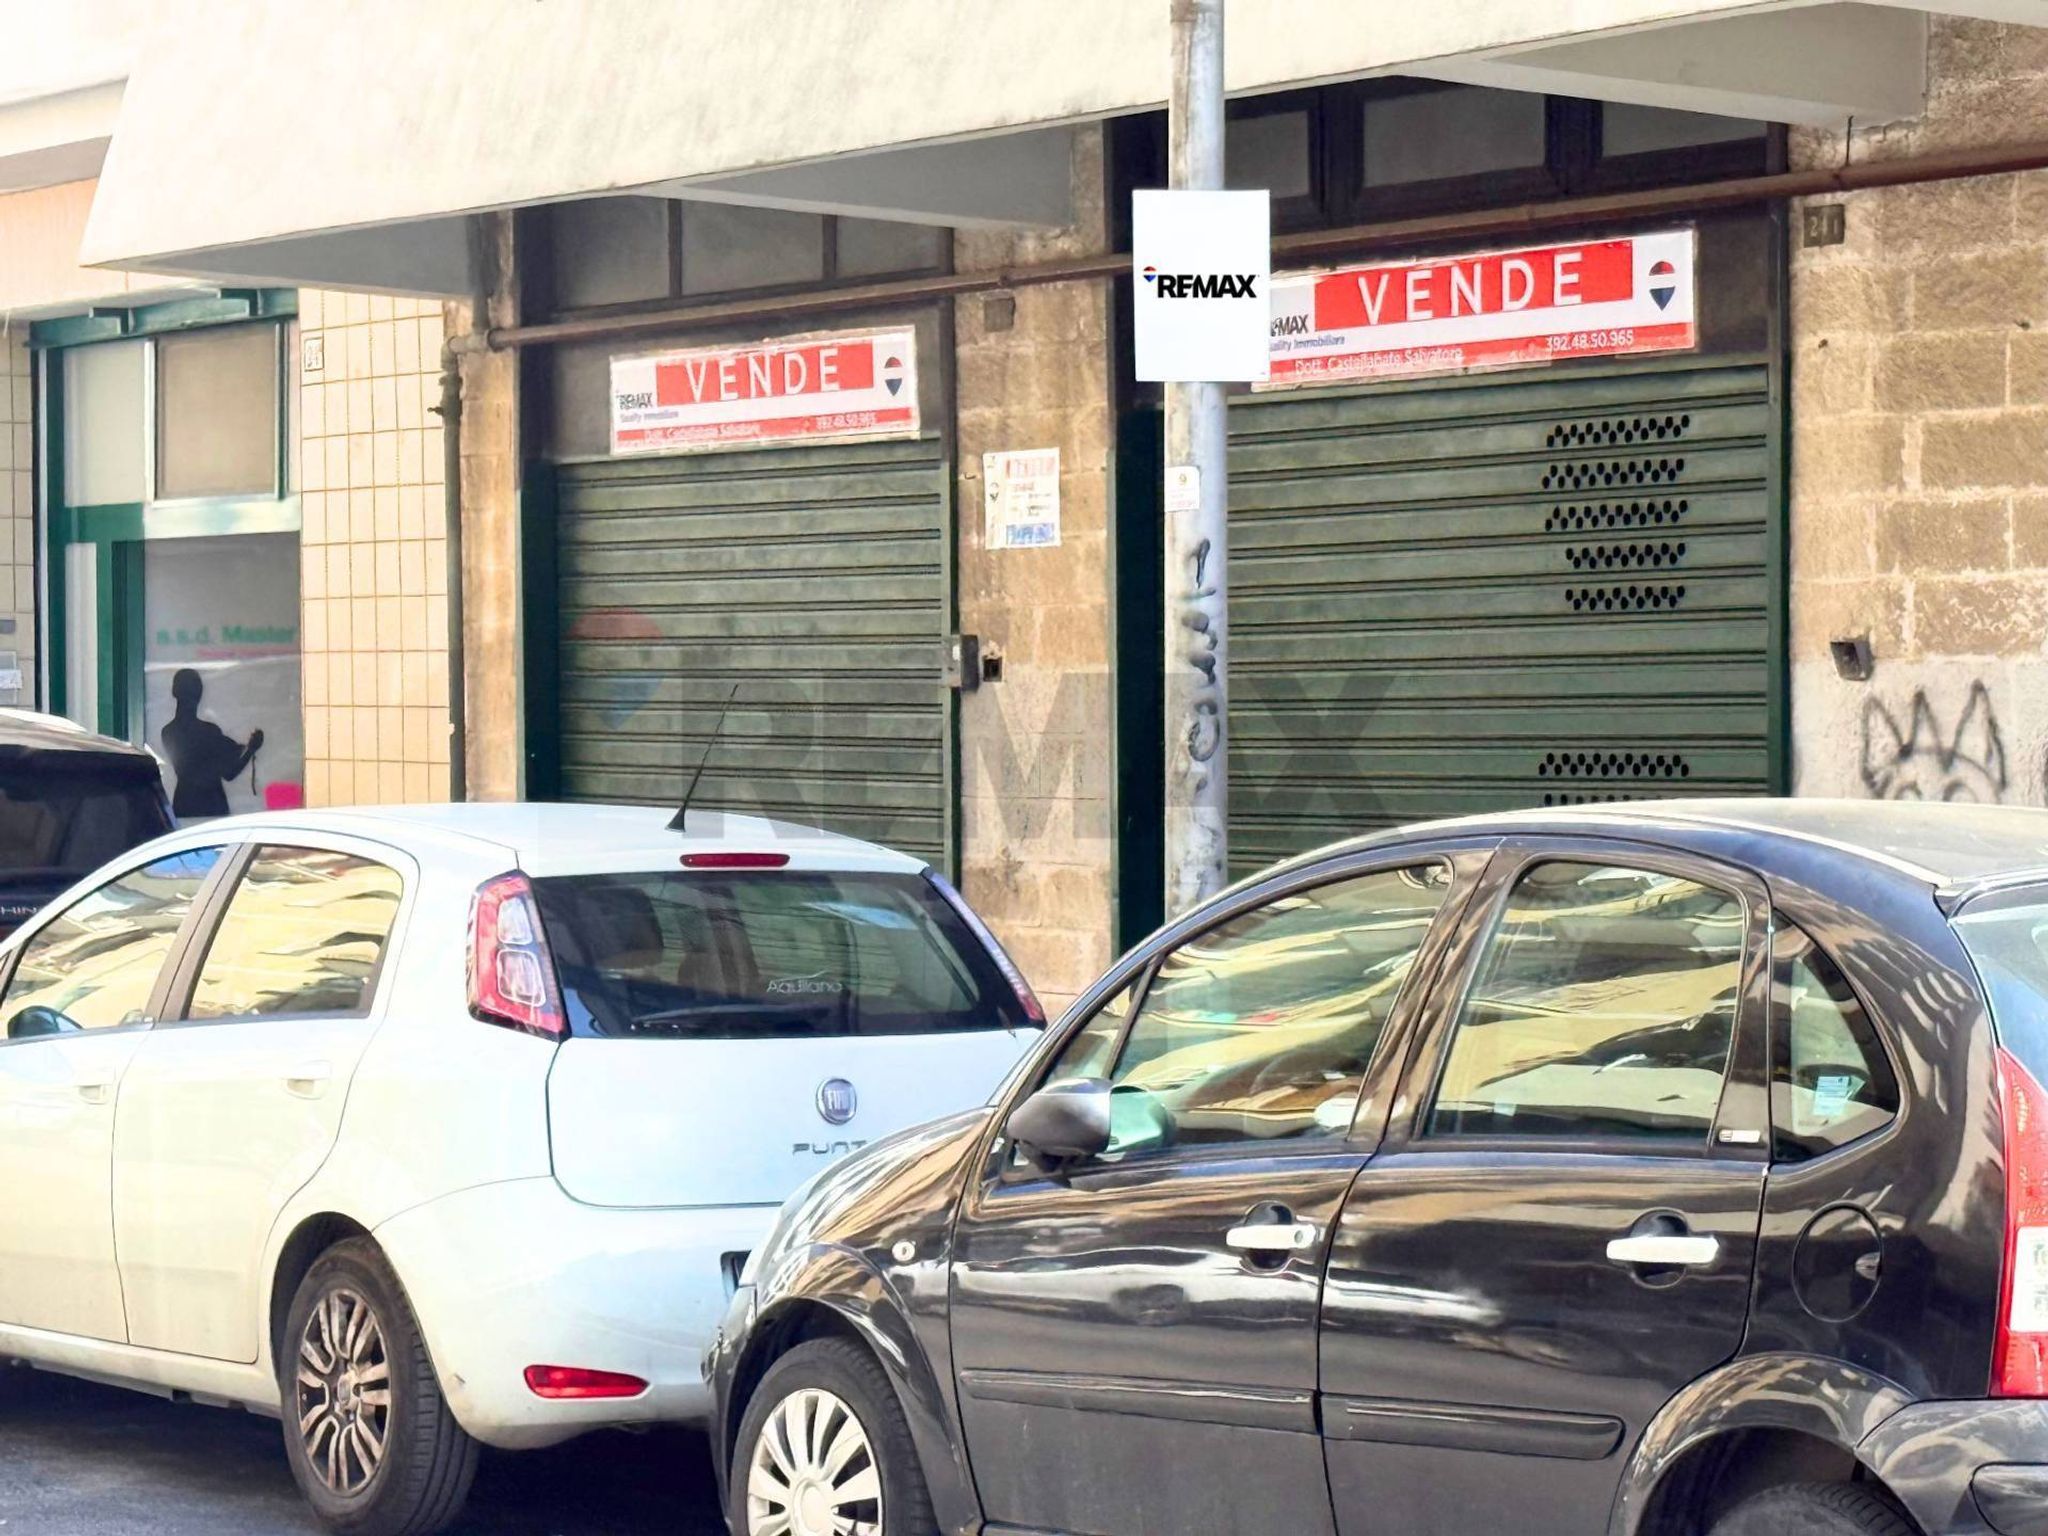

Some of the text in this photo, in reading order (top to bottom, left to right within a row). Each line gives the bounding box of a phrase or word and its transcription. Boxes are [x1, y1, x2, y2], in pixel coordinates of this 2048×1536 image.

[1358, 250, 1584, 326] VENDE
[1270, 313, 1309, 337] MAX
[685, 347, 842, 404] VENDE
